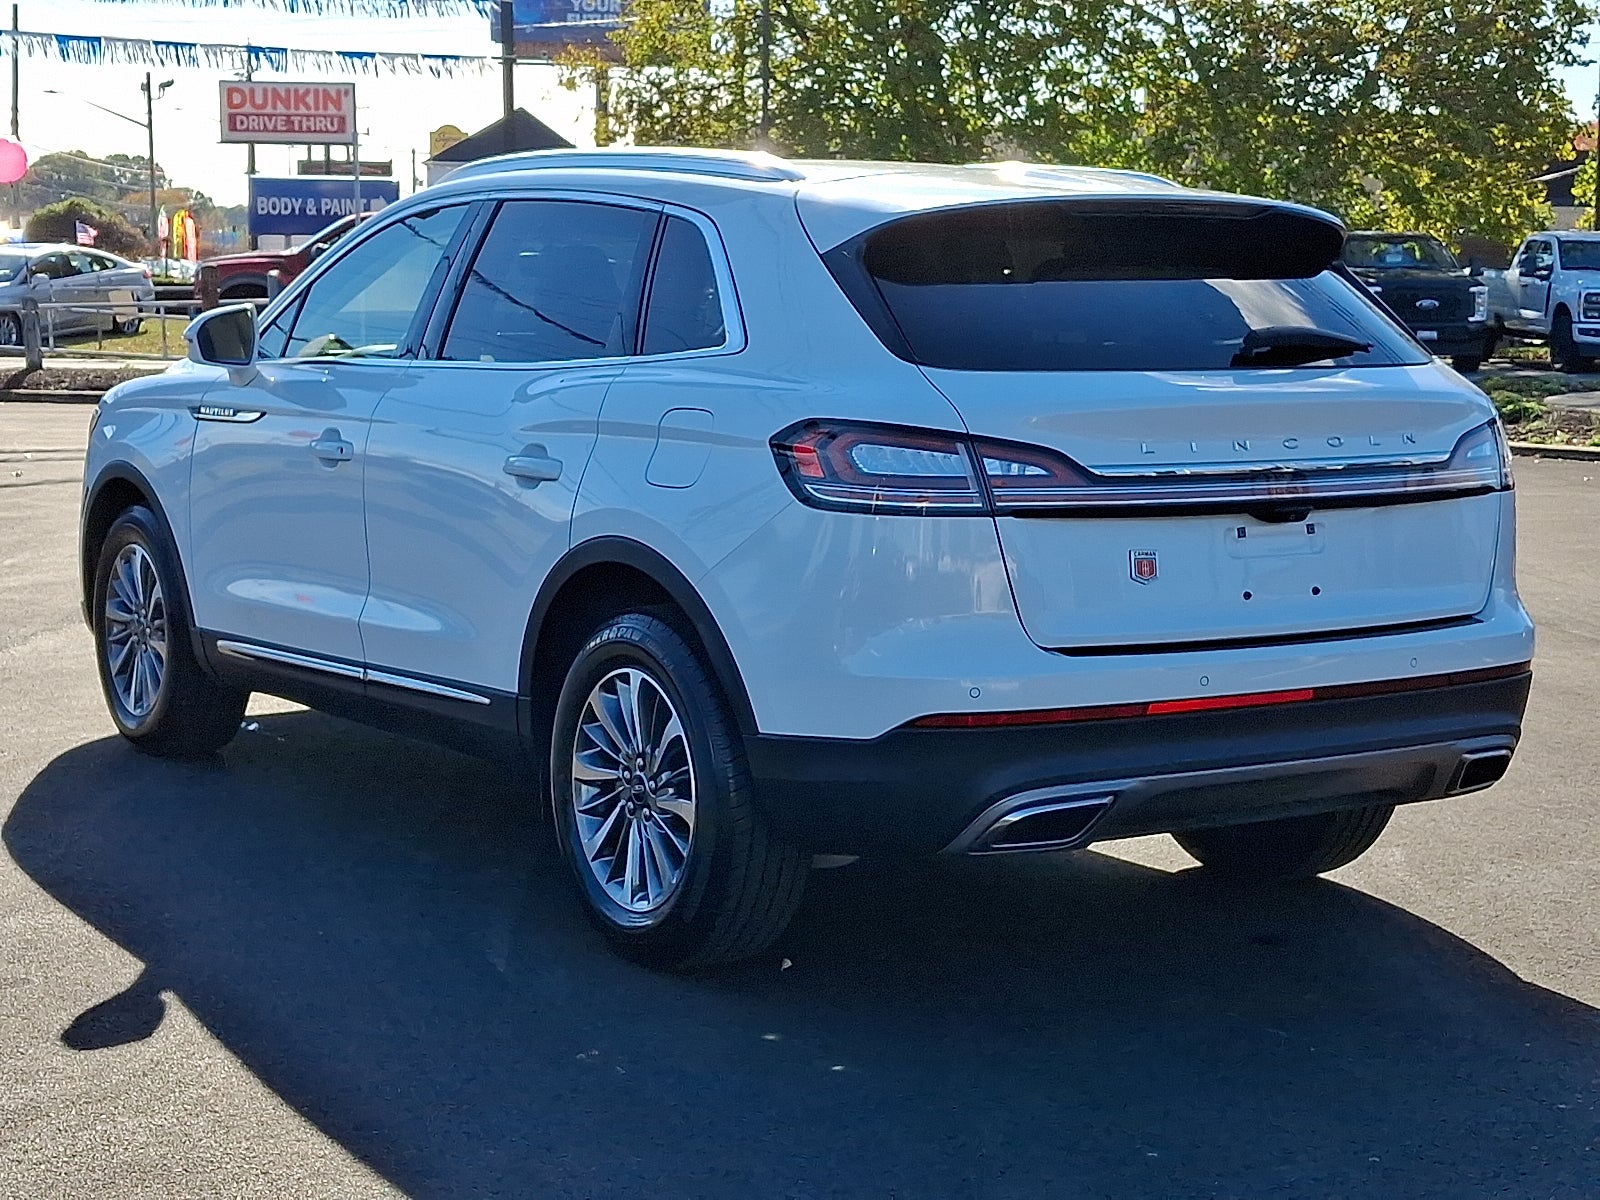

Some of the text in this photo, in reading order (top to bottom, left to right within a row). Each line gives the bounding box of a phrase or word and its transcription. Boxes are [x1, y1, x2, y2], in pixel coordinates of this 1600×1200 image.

[571, 0, 621, 12] YOUR
[226, 87, 349, 112] DUNKIN'
[236, 116, 338, 132] DRIVE THRU
[257, 196, 367, 216] BODY & PAINT
[1141, 433, 1416, 455] LINCOLN
